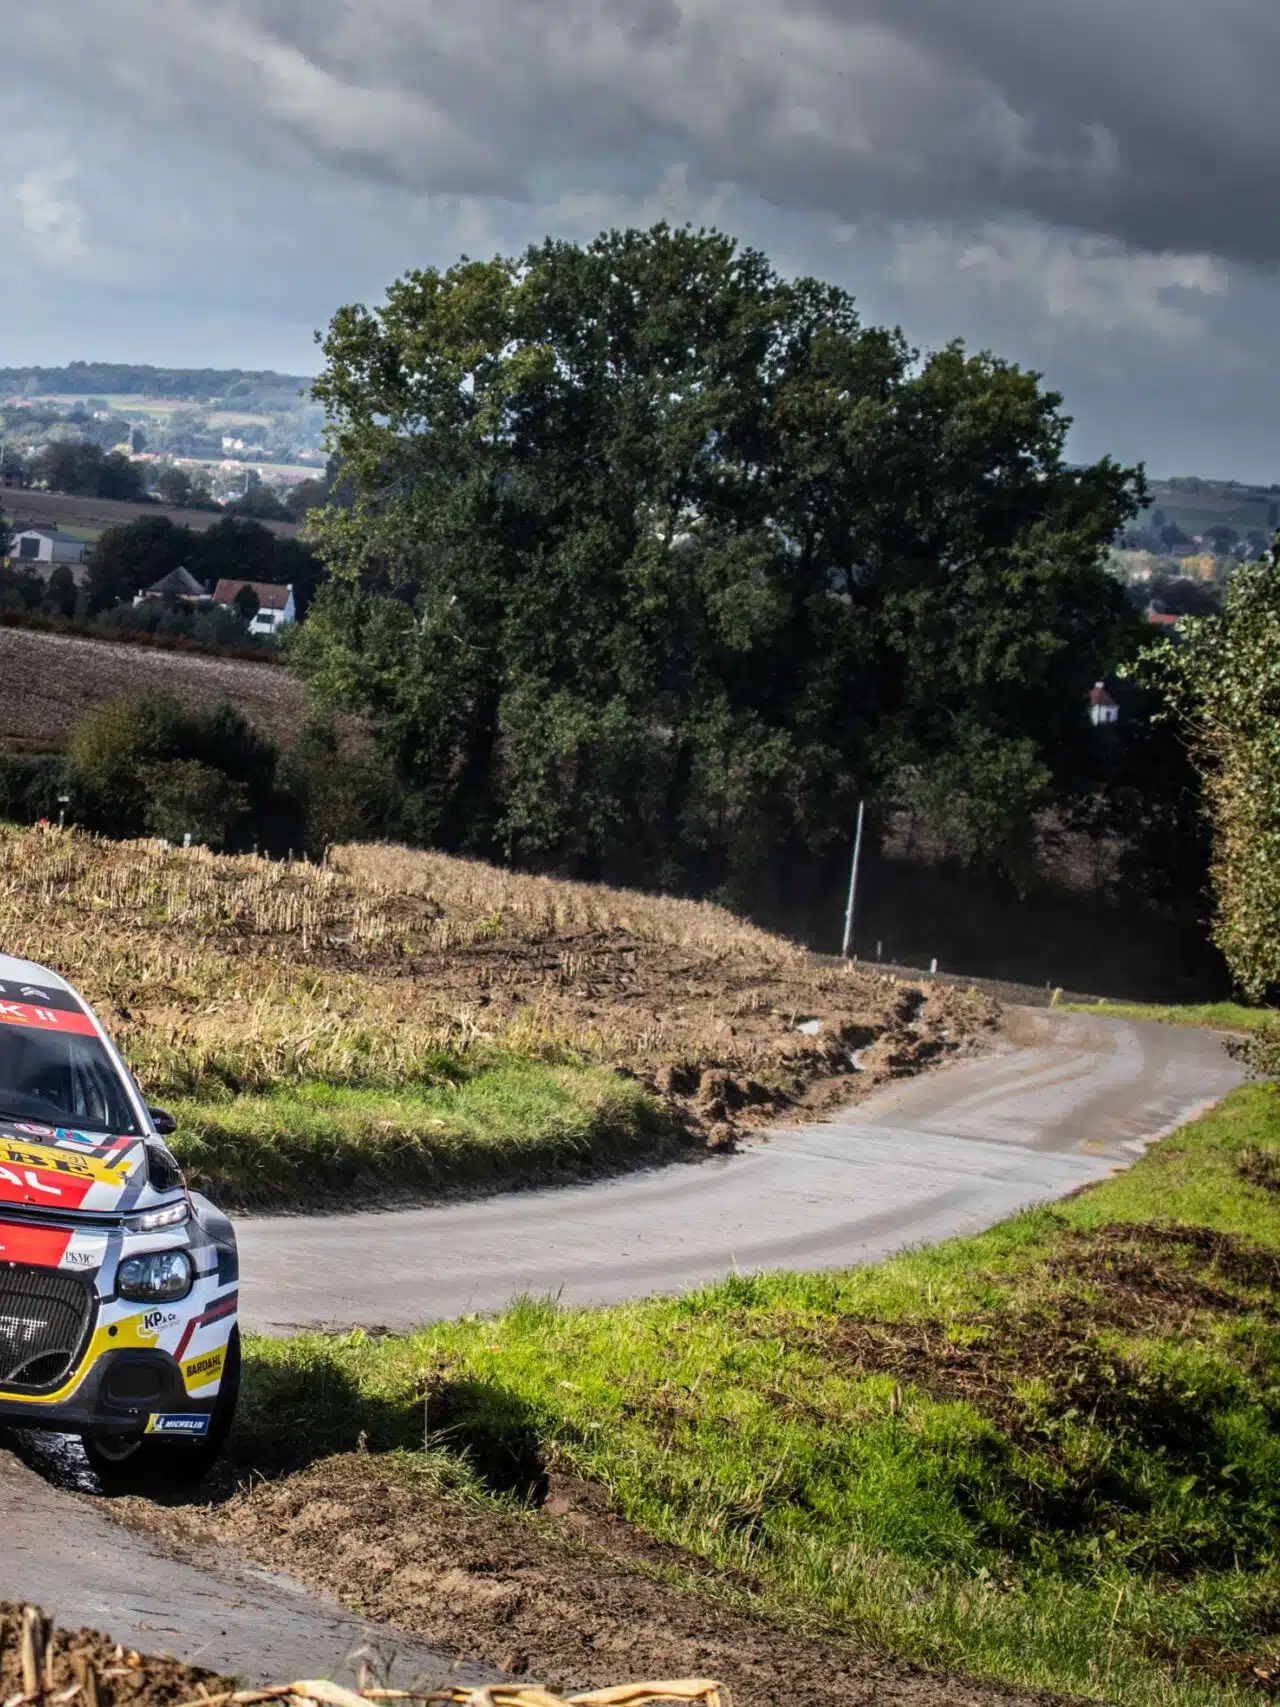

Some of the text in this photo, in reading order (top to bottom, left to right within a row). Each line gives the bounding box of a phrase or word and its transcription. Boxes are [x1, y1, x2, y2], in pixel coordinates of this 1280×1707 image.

[144, 1311, 162, 1329] KP
[186, 1355, 222, 1377] BARDAHL
[164, 1420, 205, 1429] MICHELIN
